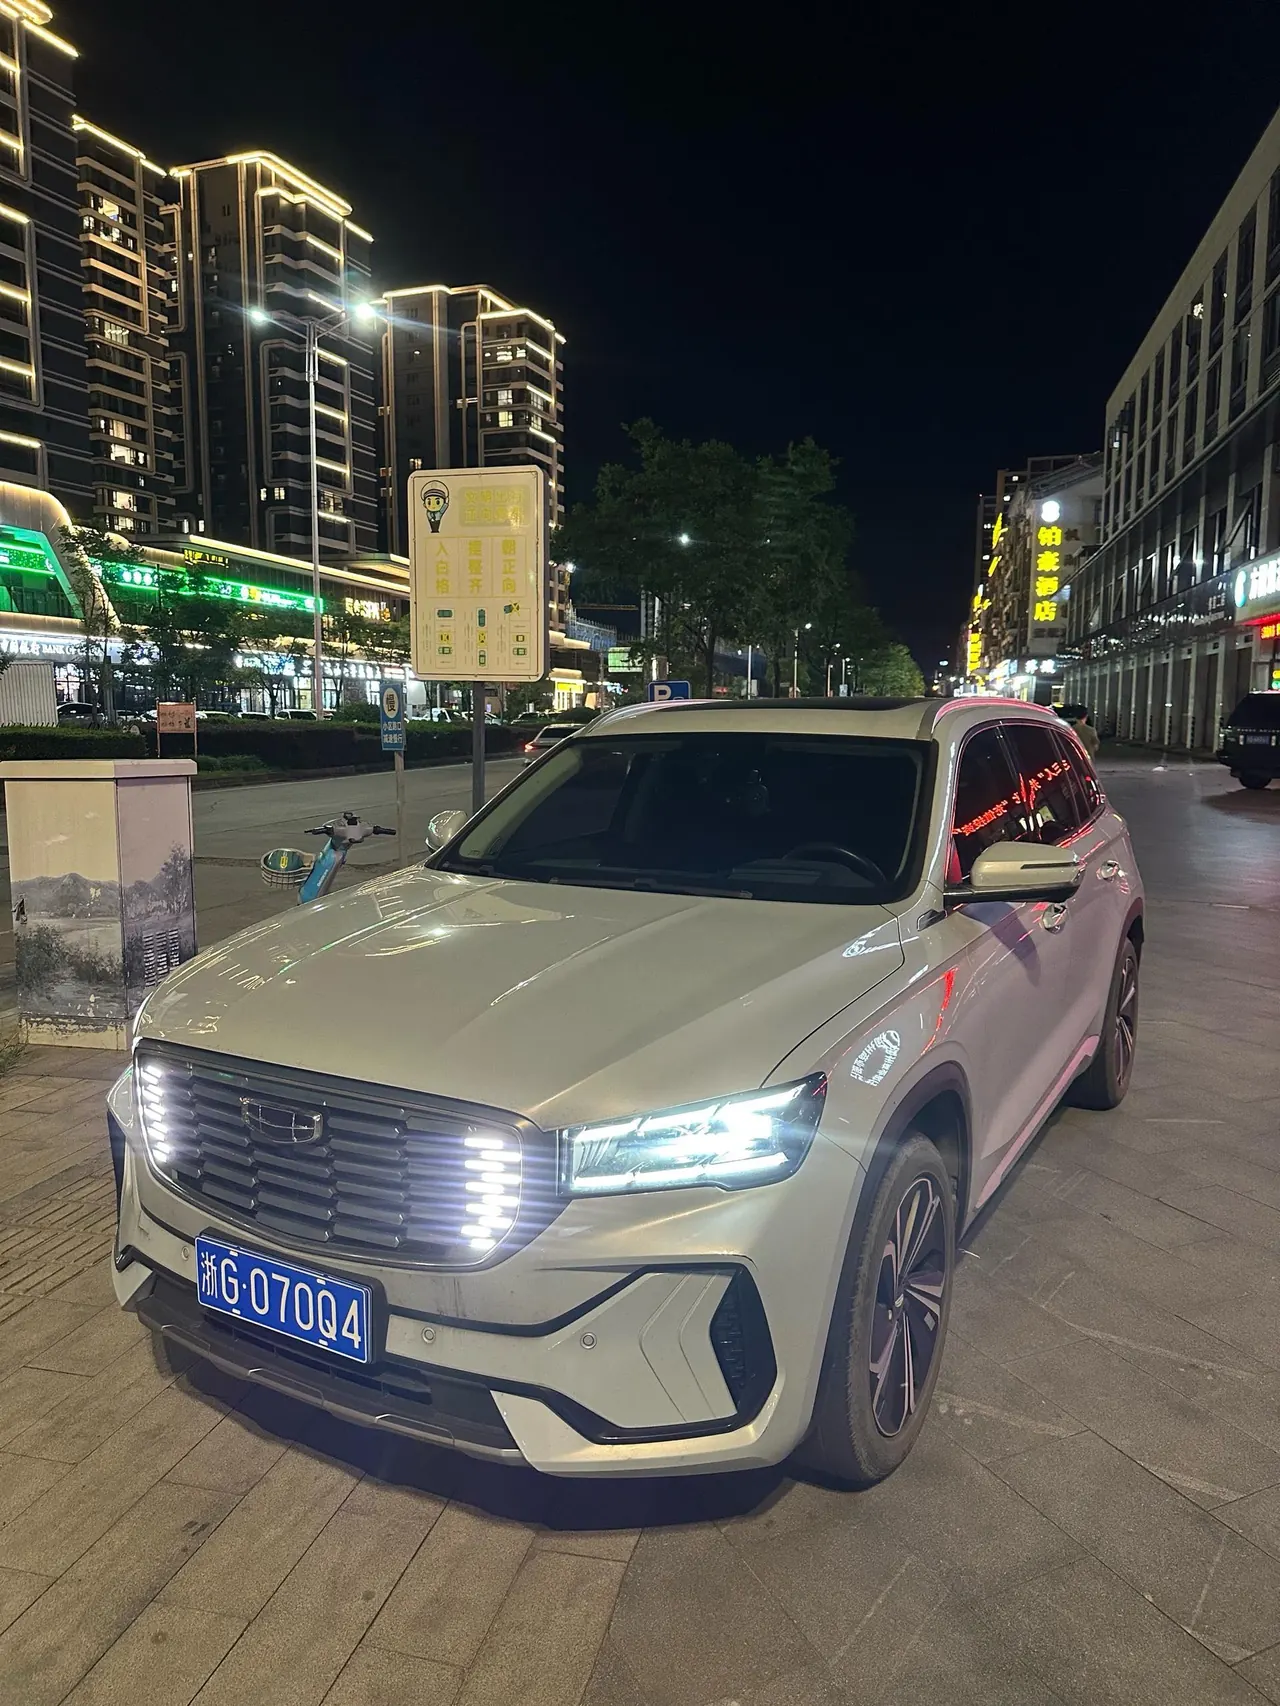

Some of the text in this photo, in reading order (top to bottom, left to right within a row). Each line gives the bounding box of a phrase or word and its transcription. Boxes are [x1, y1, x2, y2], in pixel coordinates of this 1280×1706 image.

[42, 644, 65, 654] BANK
[654, 685, 671, 701] P
[386, 693, 396, 712] 慢
